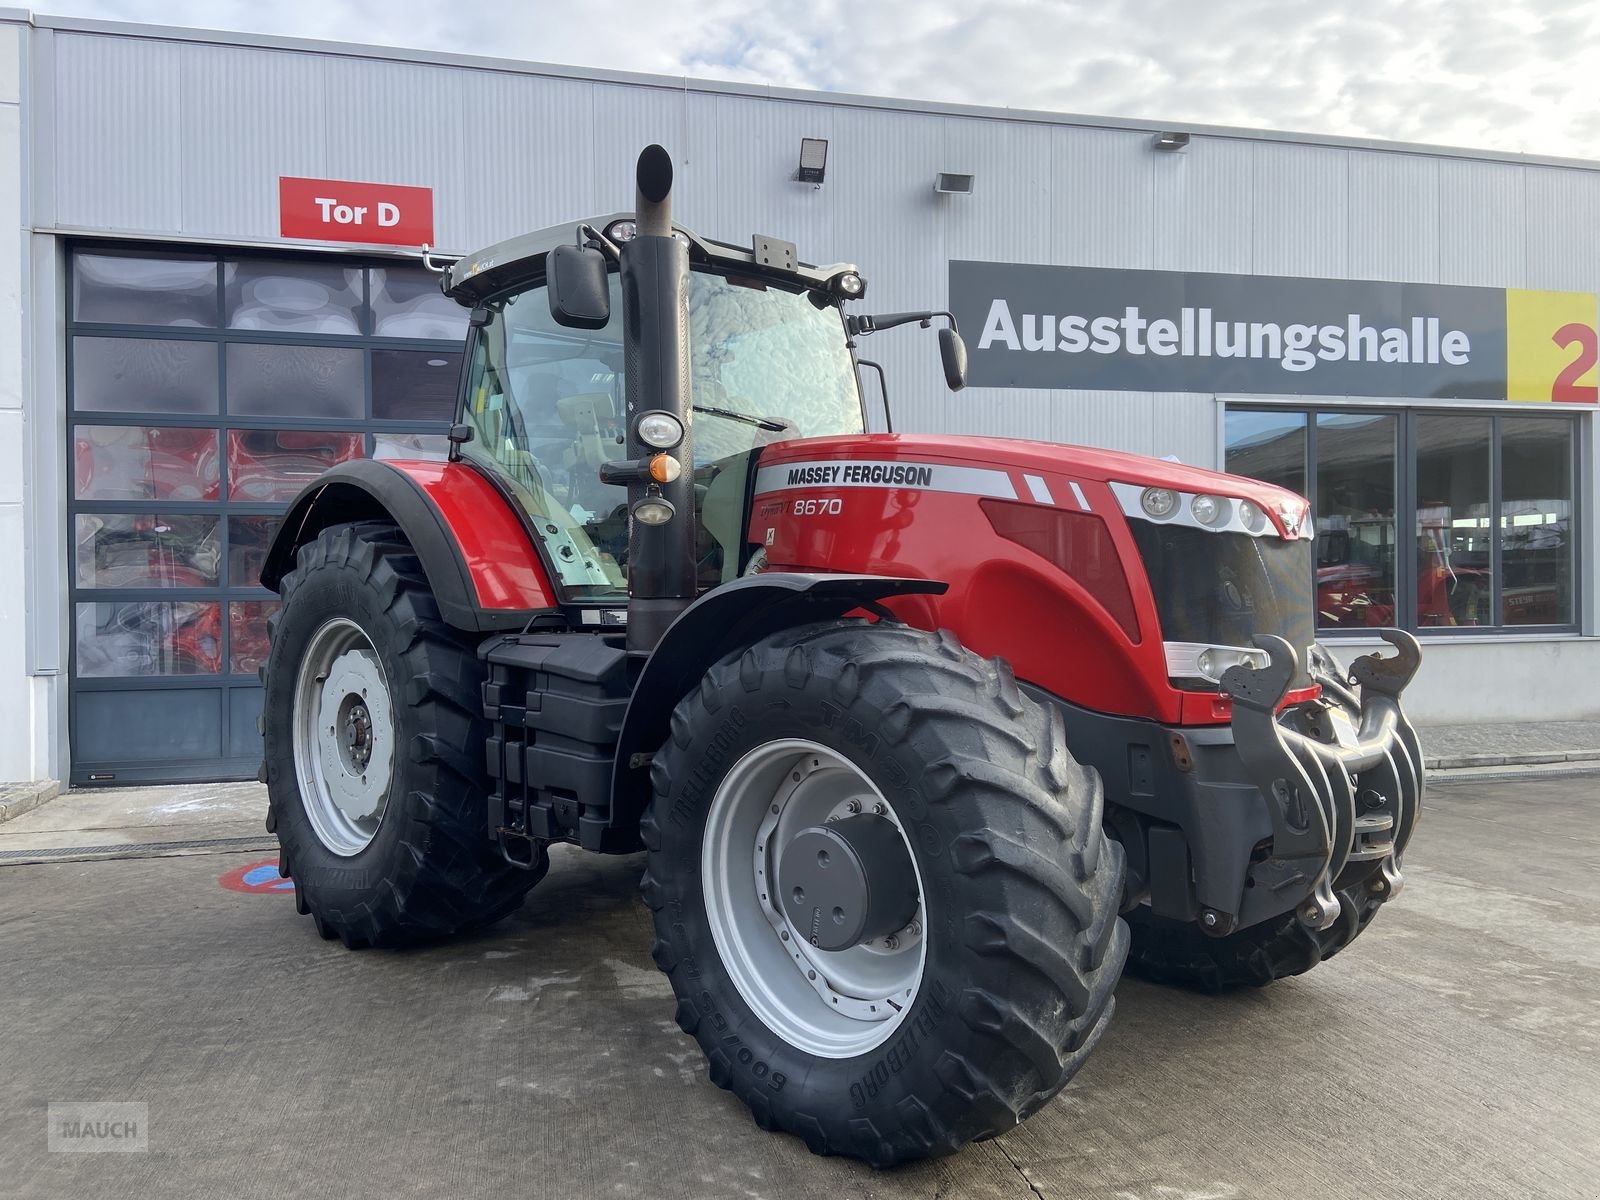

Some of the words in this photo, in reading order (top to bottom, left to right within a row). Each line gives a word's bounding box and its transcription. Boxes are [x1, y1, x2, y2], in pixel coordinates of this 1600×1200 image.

[315, 197, 368, 225] Tor
[378, 202, 400, 227] D
[978, 299, 1471, 372] Ausstellungshalle
[1551, 322, 1598, 403] 2
[787, 466, 840, 485] MASSEY
[843, 465, 932, 486] FERGUSON
[794, 498, 842, 515] 8670
[668, 704, 746, 828] TRELLEBORG
[850, 976, 953, 1109] TRELLEBORG
